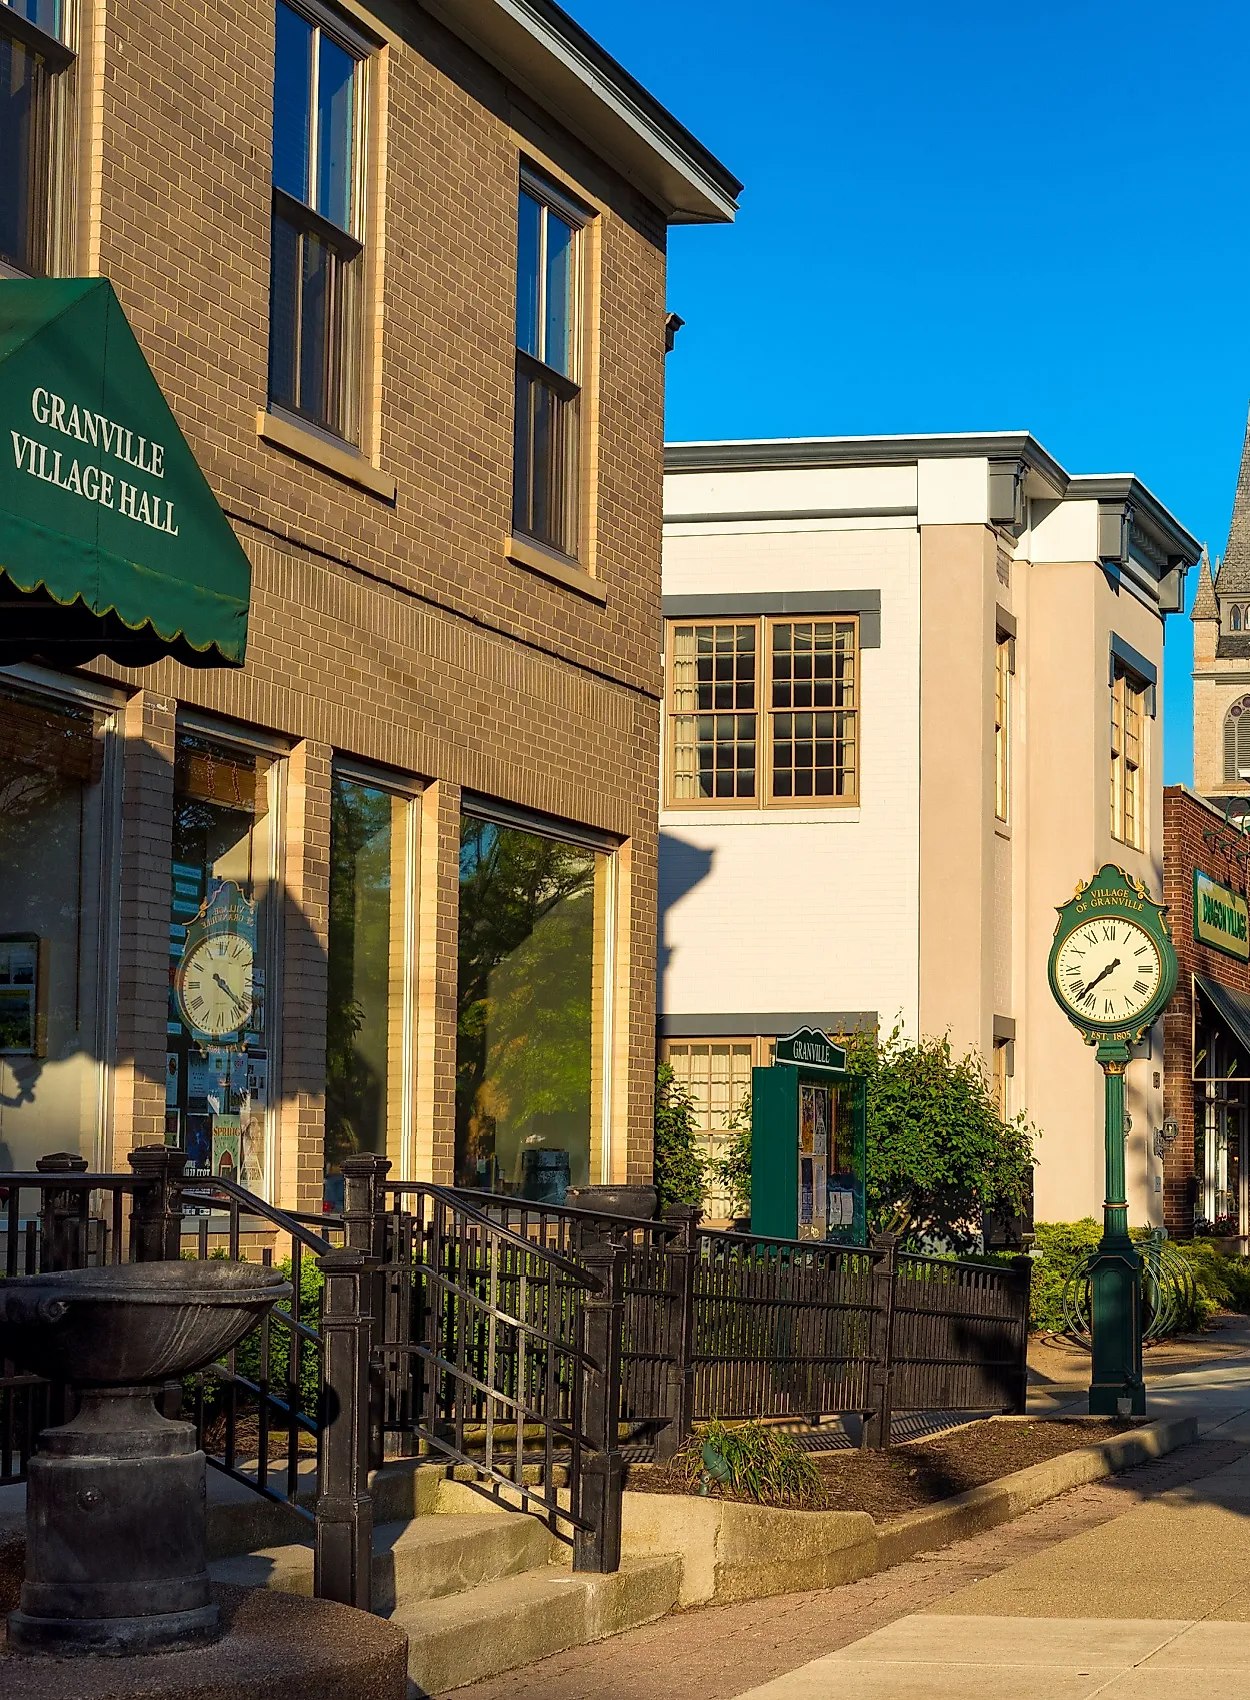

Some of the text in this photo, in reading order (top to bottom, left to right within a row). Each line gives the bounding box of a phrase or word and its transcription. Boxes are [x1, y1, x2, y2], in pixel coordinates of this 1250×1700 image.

[31, 387, 165, 478] GRANVILLE
[10, 429, 179, 536] VILLAGE HALL
[1091, 889, 1129, 898] VILLAGE
[1075, 897, 1145, 914] OF GRANVILLE
[1226, 905, 1248, 943] VILLAGE
[1091, 1031, 1131, 1041] EST. 1805
[793, 1040, 830, 1063] GRANVILLE
[213, 1127, 240, 1137] SPRING
